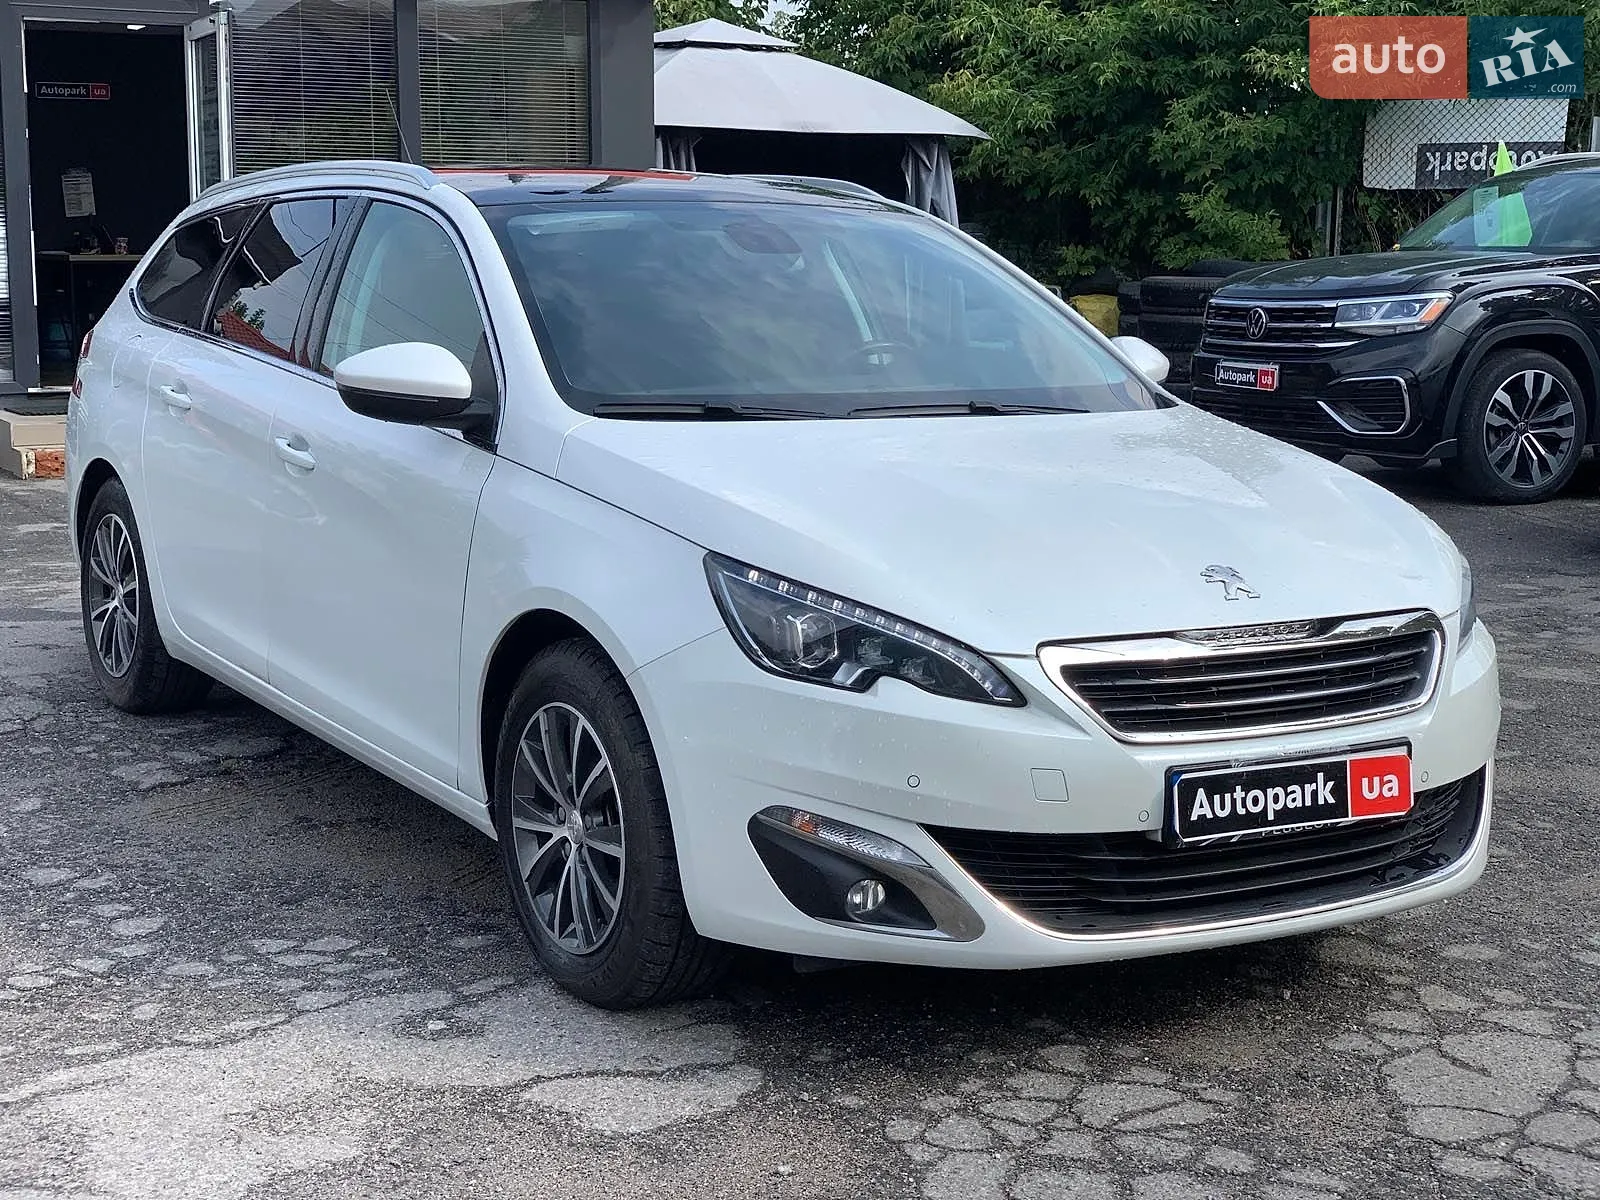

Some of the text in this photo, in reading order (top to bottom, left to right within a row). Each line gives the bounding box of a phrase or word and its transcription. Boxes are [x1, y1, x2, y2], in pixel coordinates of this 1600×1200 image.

[40, 85, 87, 97] Autopark
[1425, 145, 1558, 181] uopark
[1217, 368, 1273, 385] Autopark ua
[1190, 772, 1400, 820] Autopark ua
